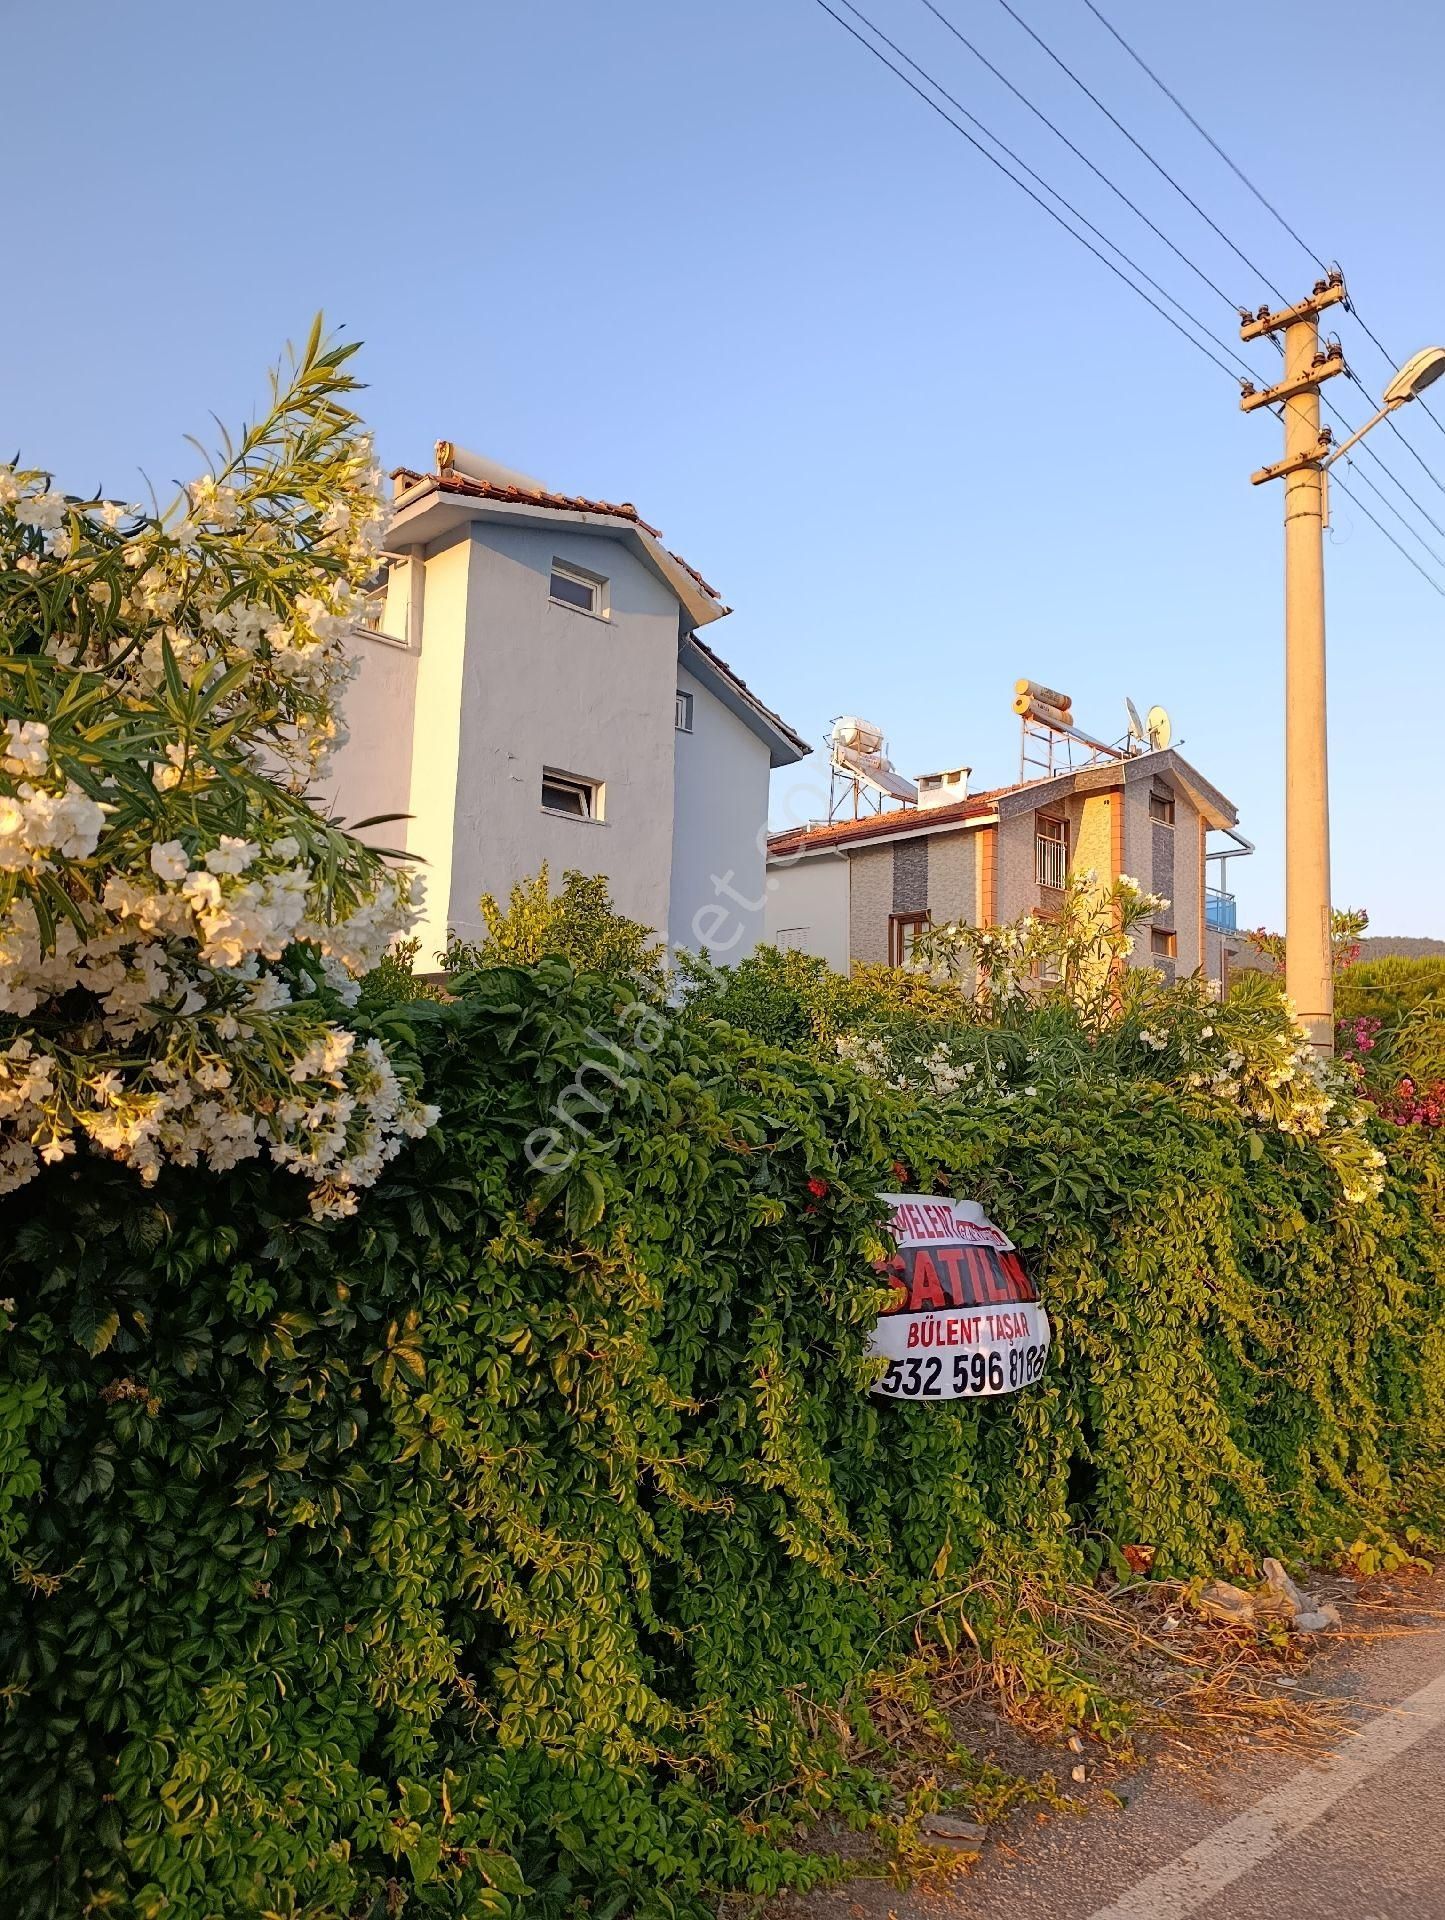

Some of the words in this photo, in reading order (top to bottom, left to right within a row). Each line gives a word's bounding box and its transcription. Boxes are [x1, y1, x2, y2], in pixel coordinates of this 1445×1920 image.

[907, 1315, 982, 1348] BÜLENT
[985, 1312, 1030, 1345] TAŞAR
[870, 1356, 943, 1396] 532
[952, 1350, 1004, 1393] 596
